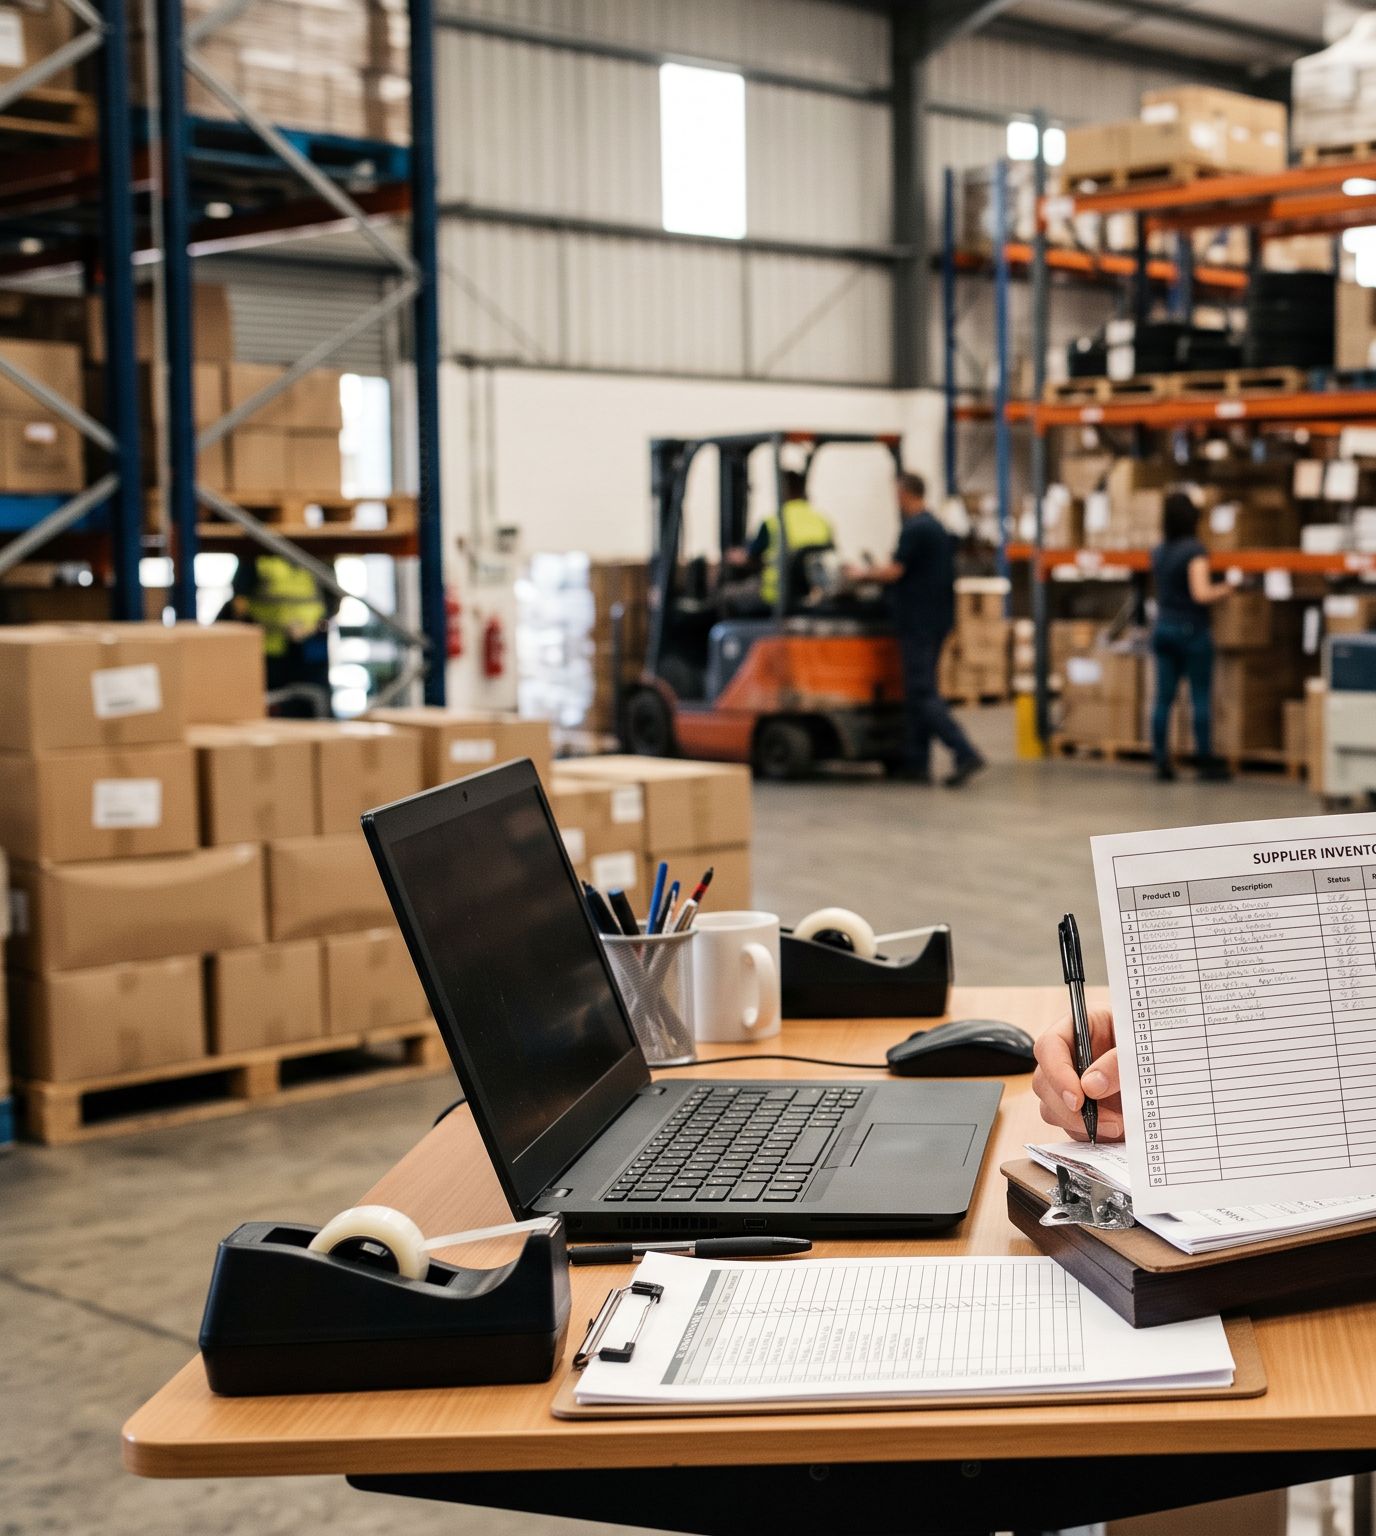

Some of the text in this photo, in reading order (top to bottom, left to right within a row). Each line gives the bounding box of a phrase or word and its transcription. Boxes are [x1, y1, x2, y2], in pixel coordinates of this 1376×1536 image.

[1253, 848, 1317, 865] SUPPLIER
[1231, 882, 1273, 893] Description
[1142, 890, 1181, 901] Product ID
